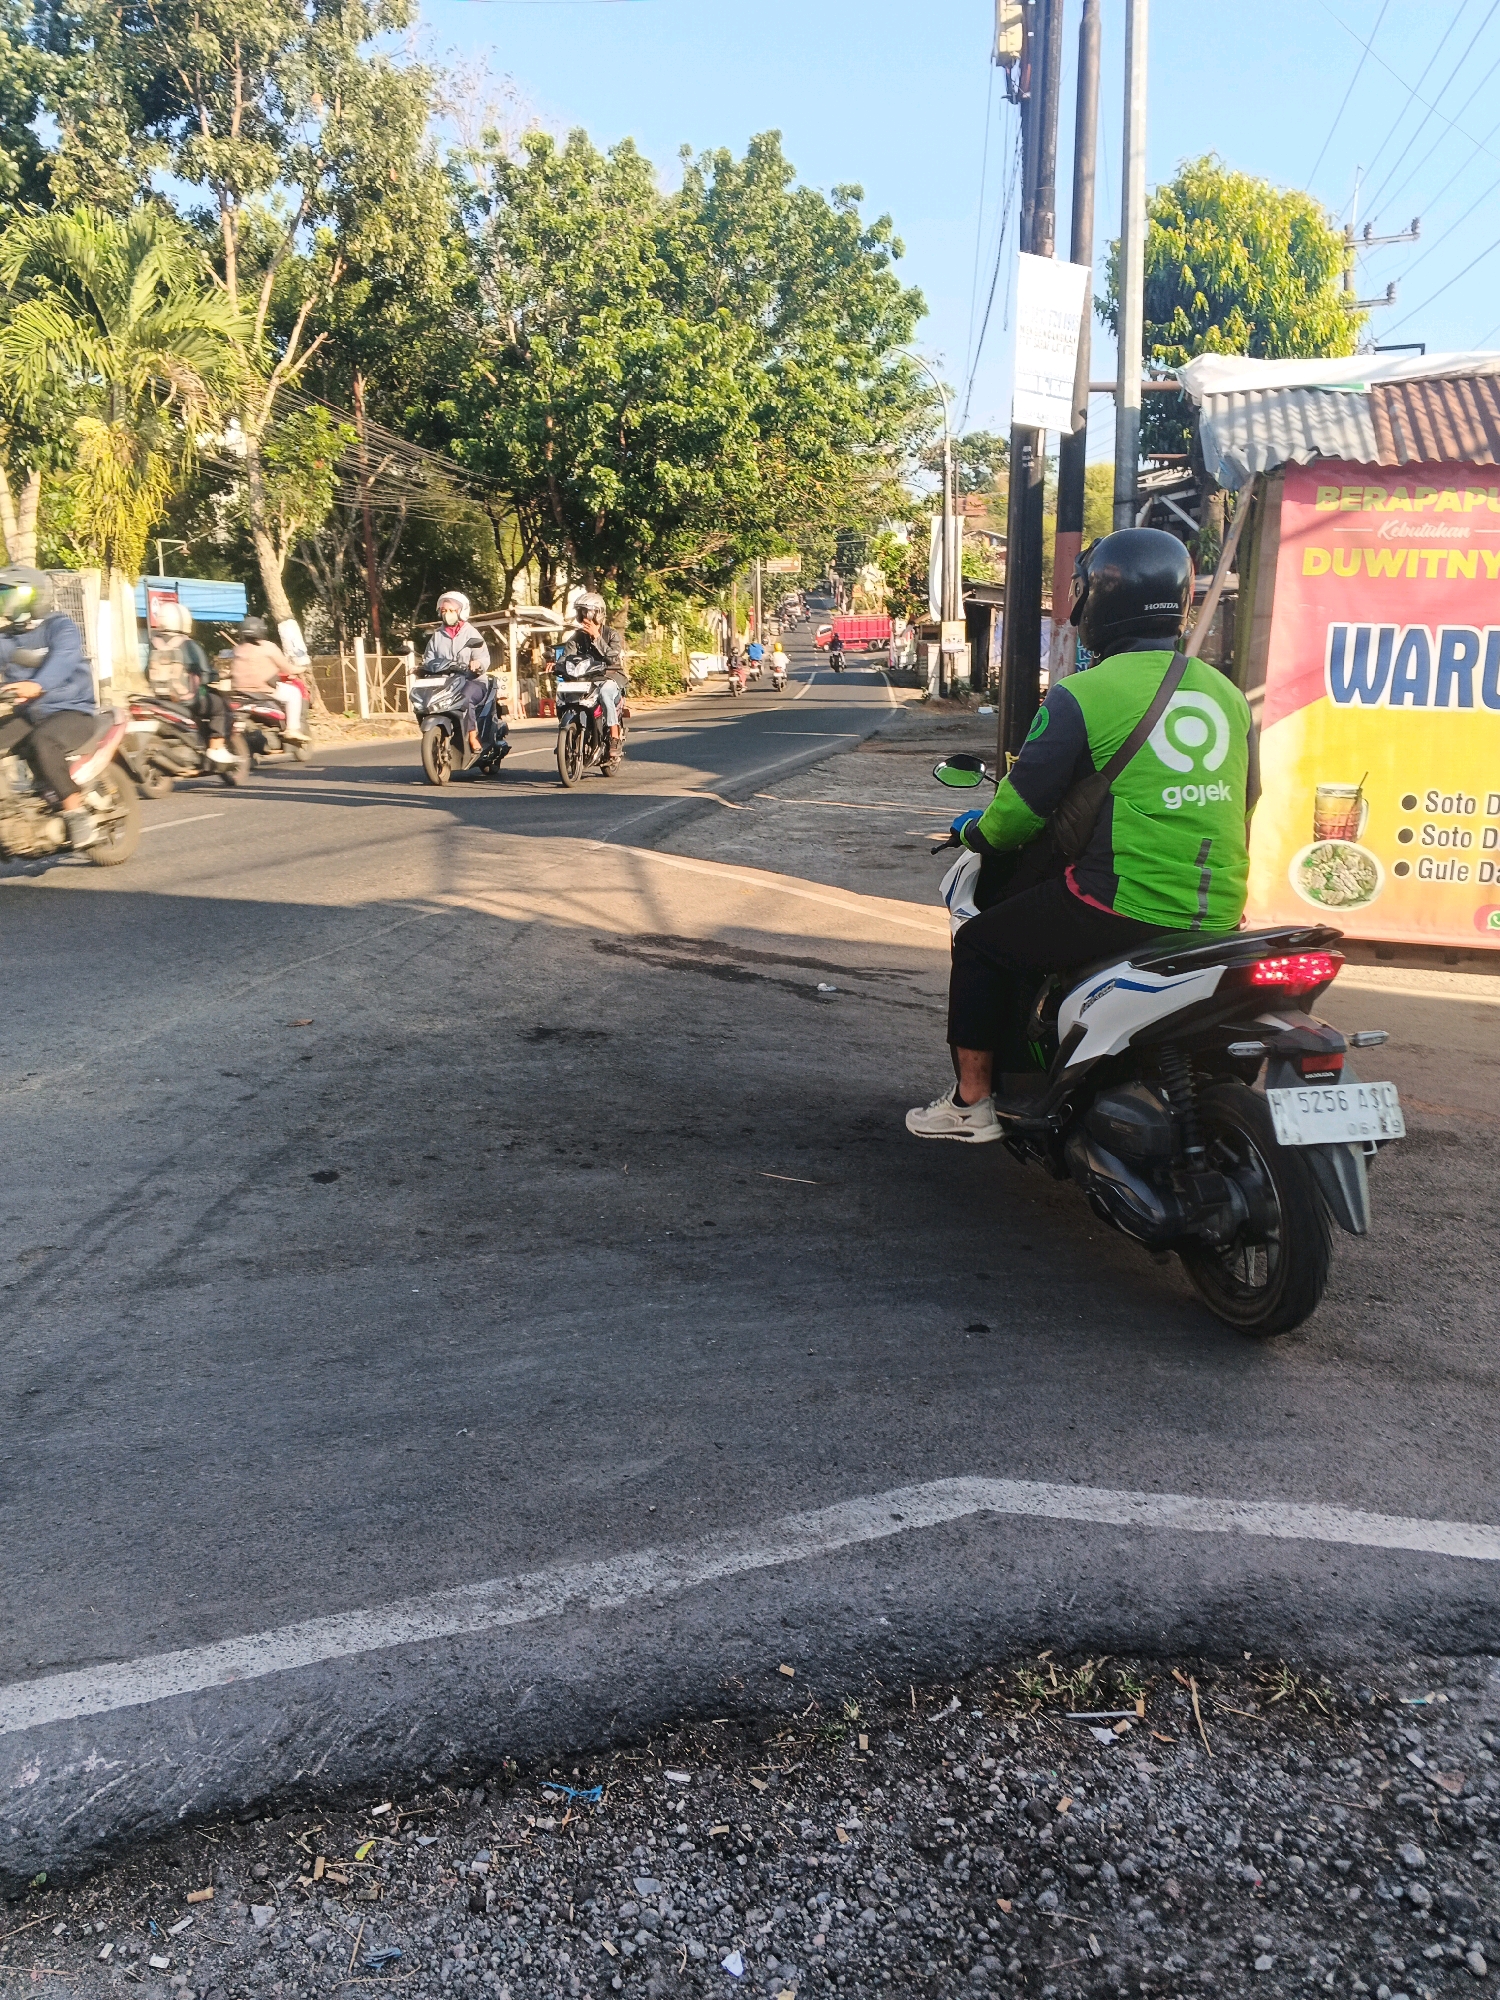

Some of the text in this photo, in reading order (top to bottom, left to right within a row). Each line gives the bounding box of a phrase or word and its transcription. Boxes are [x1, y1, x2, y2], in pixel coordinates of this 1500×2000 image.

[1377, 520, 1471, 540] Kebutuhan
[1302, 547, 1500, 579] DUWITNY
[1144, 602, 1179, 611] HONDA
[1162, 780, 1232, 809] gojek
[1425, 790, 1476, 814] Soto
[1421, 824, 1472, 848] Soto
[1418, 858, 1469, 882] Gule
[1297, 1090, 1348, 1113] 5256
